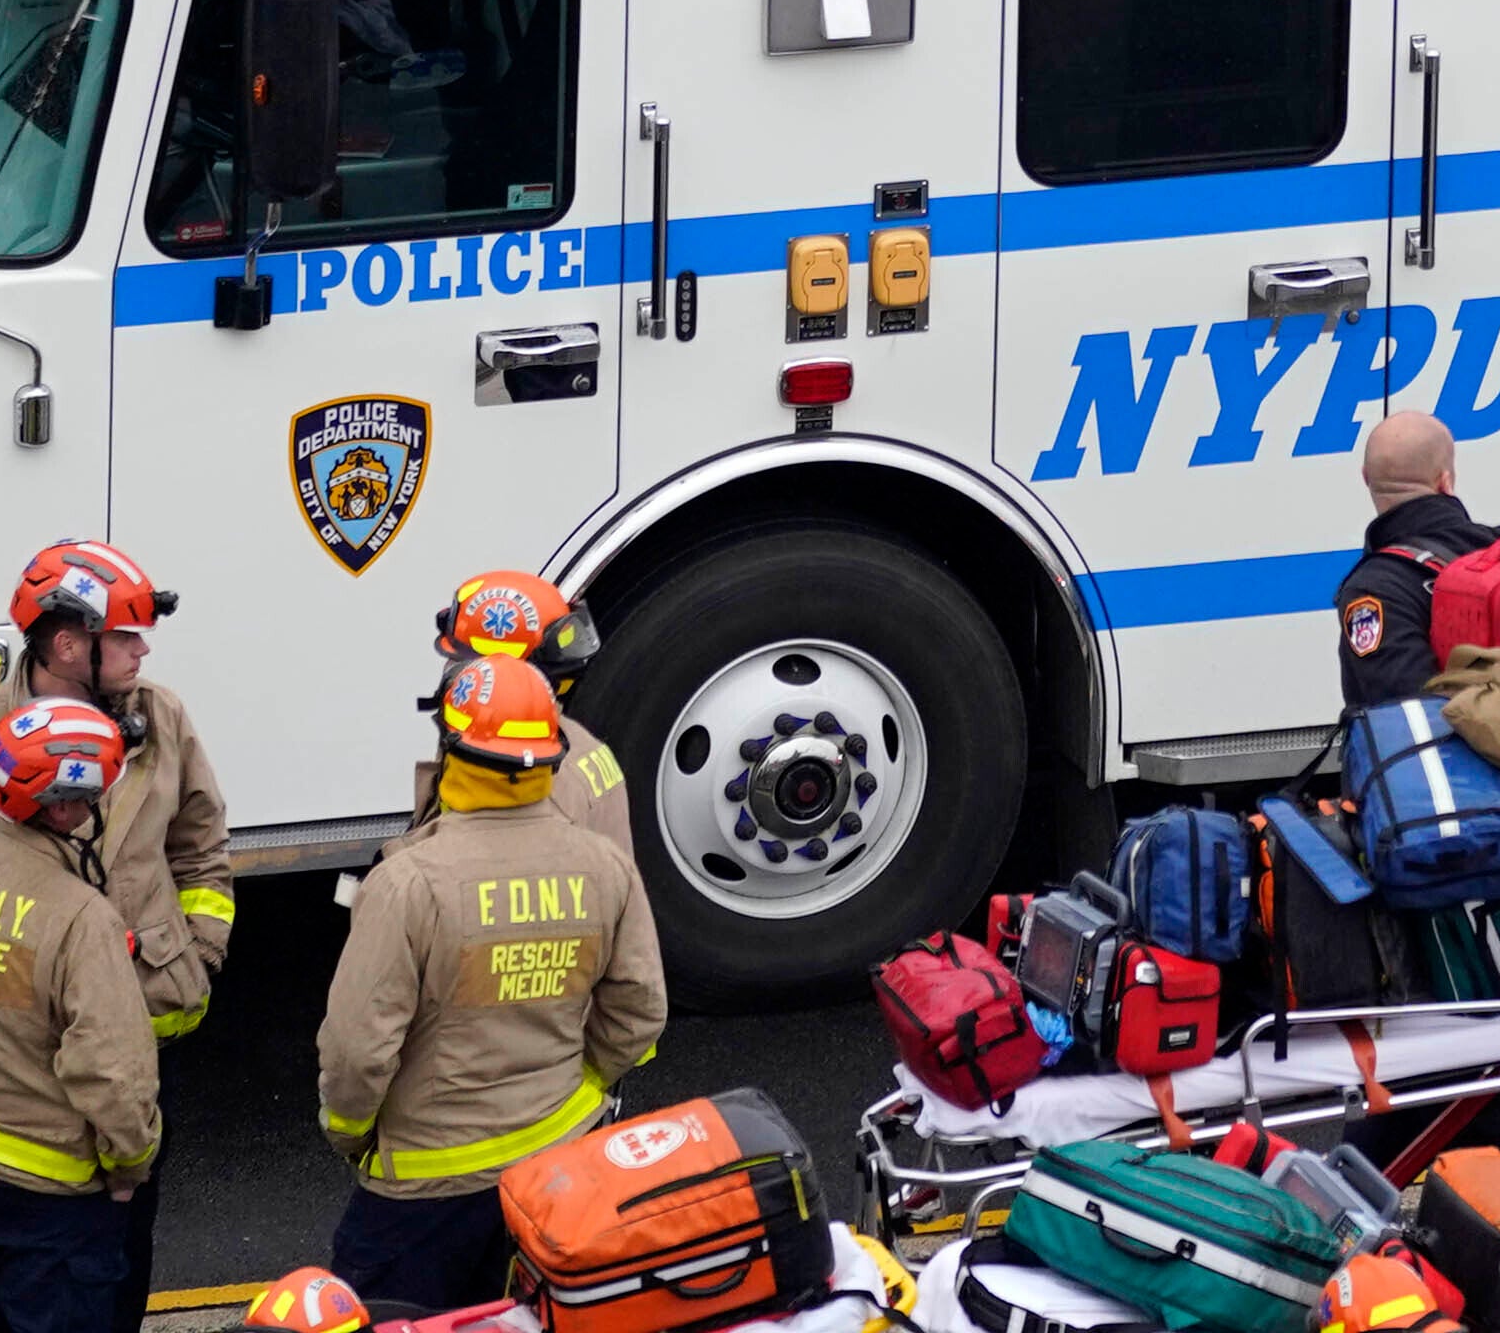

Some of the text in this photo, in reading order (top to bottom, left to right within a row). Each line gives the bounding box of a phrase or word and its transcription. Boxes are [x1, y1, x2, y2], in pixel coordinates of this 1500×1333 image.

[301, 228, 586, 310] POLICE
[324, 402, 398, 427] POLICE
[298, 421, 422, 460] DEPARTMENT
[300, 458, 422, 551] CITY OF NEW YORK
[490, 938, 578, 975] RESCUE
[499, 968, 566, 1002] MEDIC
